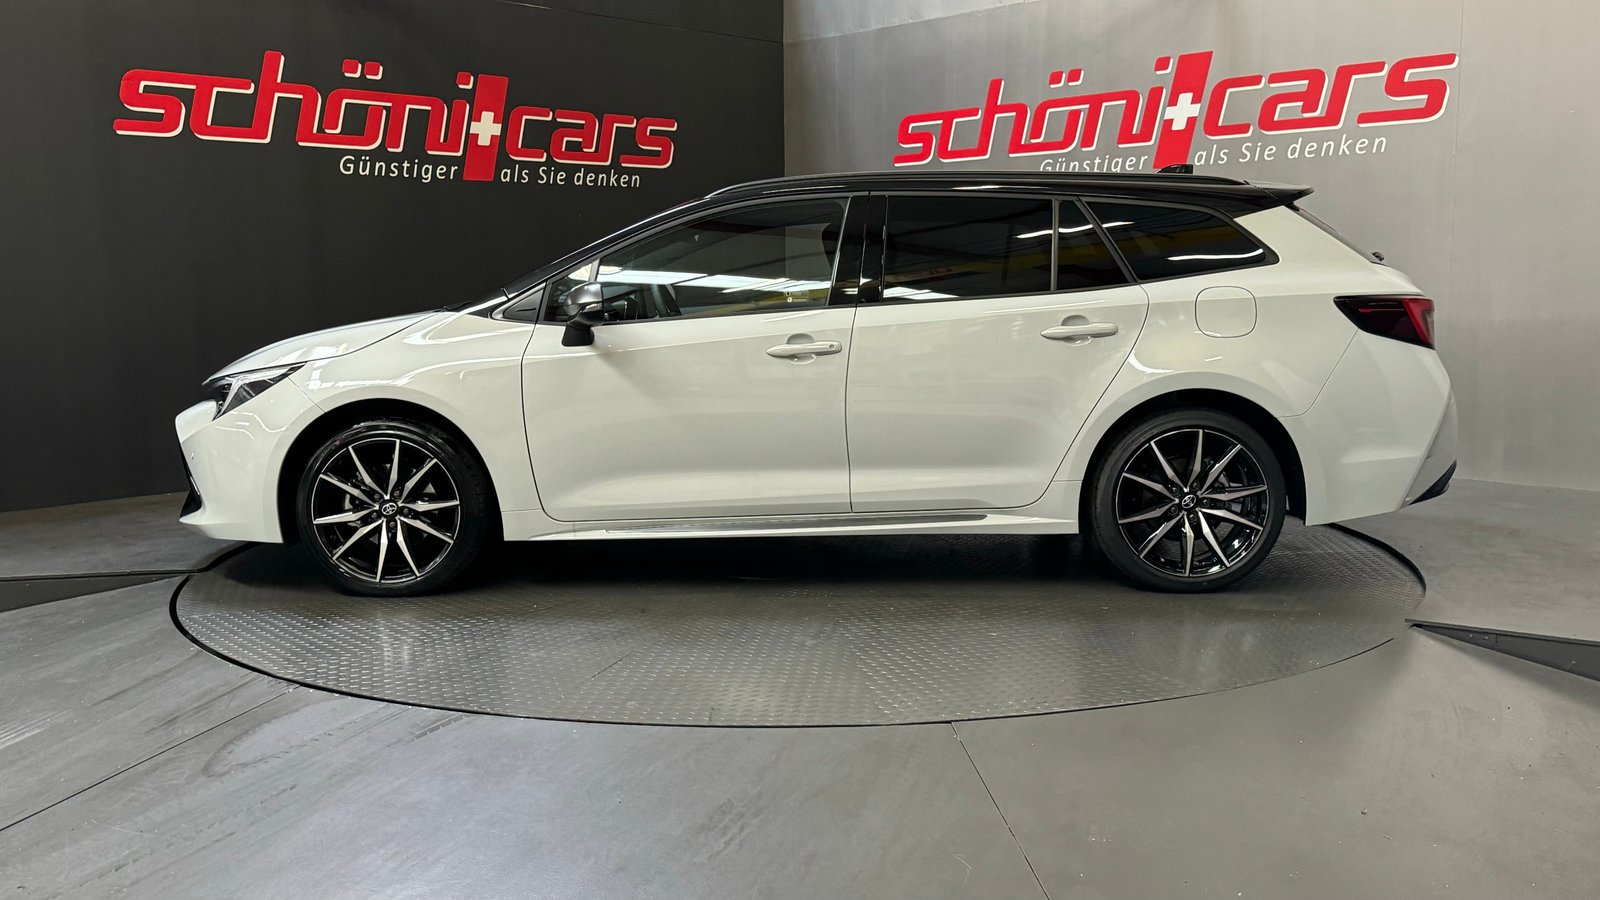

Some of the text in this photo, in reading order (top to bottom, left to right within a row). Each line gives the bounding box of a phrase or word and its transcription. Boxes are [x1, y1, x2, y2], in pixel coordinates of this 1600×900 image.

[1202, 52, 1460, 139] cars
[507, 103, 679, 170] cars
[1193, 144, 1230, 166] als
[1238, 142, 1277, 163] Sie
[1286, 133, 1388, 160] denken
[339, 155, 641, 188] Günstiger als Sie denken
